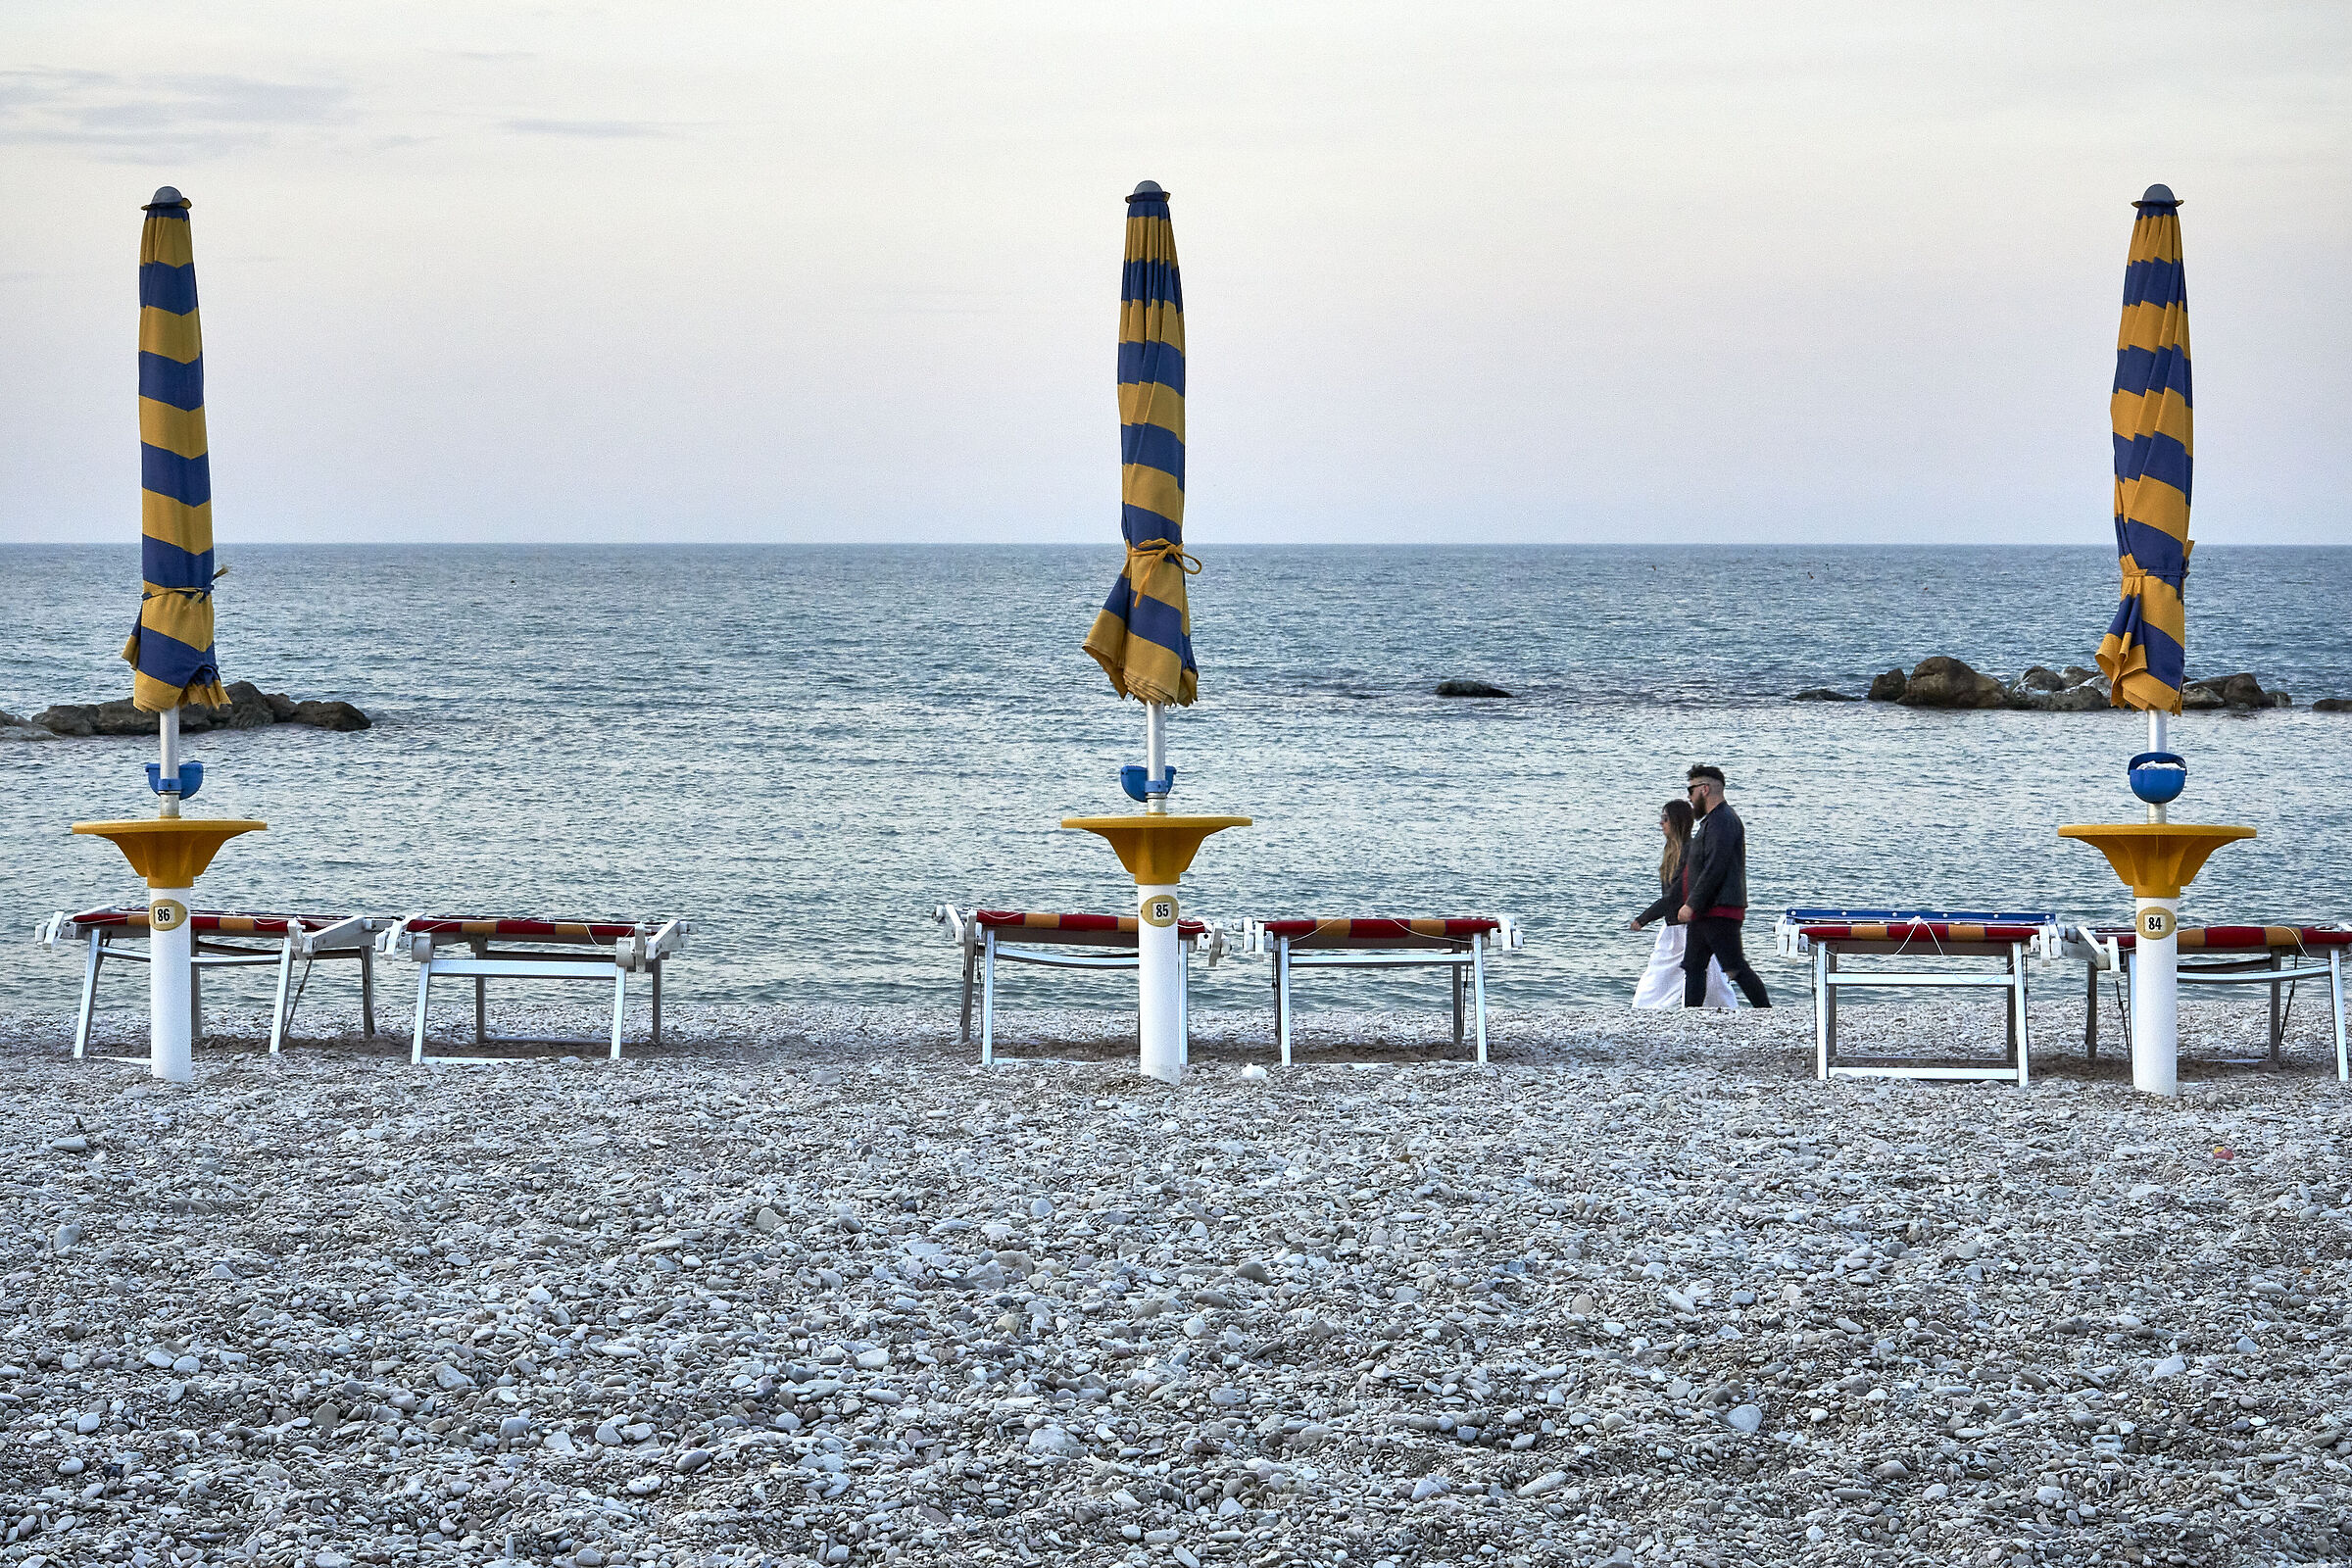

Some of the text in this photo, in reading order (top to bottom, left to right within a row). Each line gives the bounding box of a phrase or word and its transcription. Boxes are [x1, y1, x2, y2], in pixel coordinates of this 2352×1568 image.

[157, 907, 171, 922] 86
[1155, 904, 1169, 917] 85
[2148, 916, 2162, 930] 84
